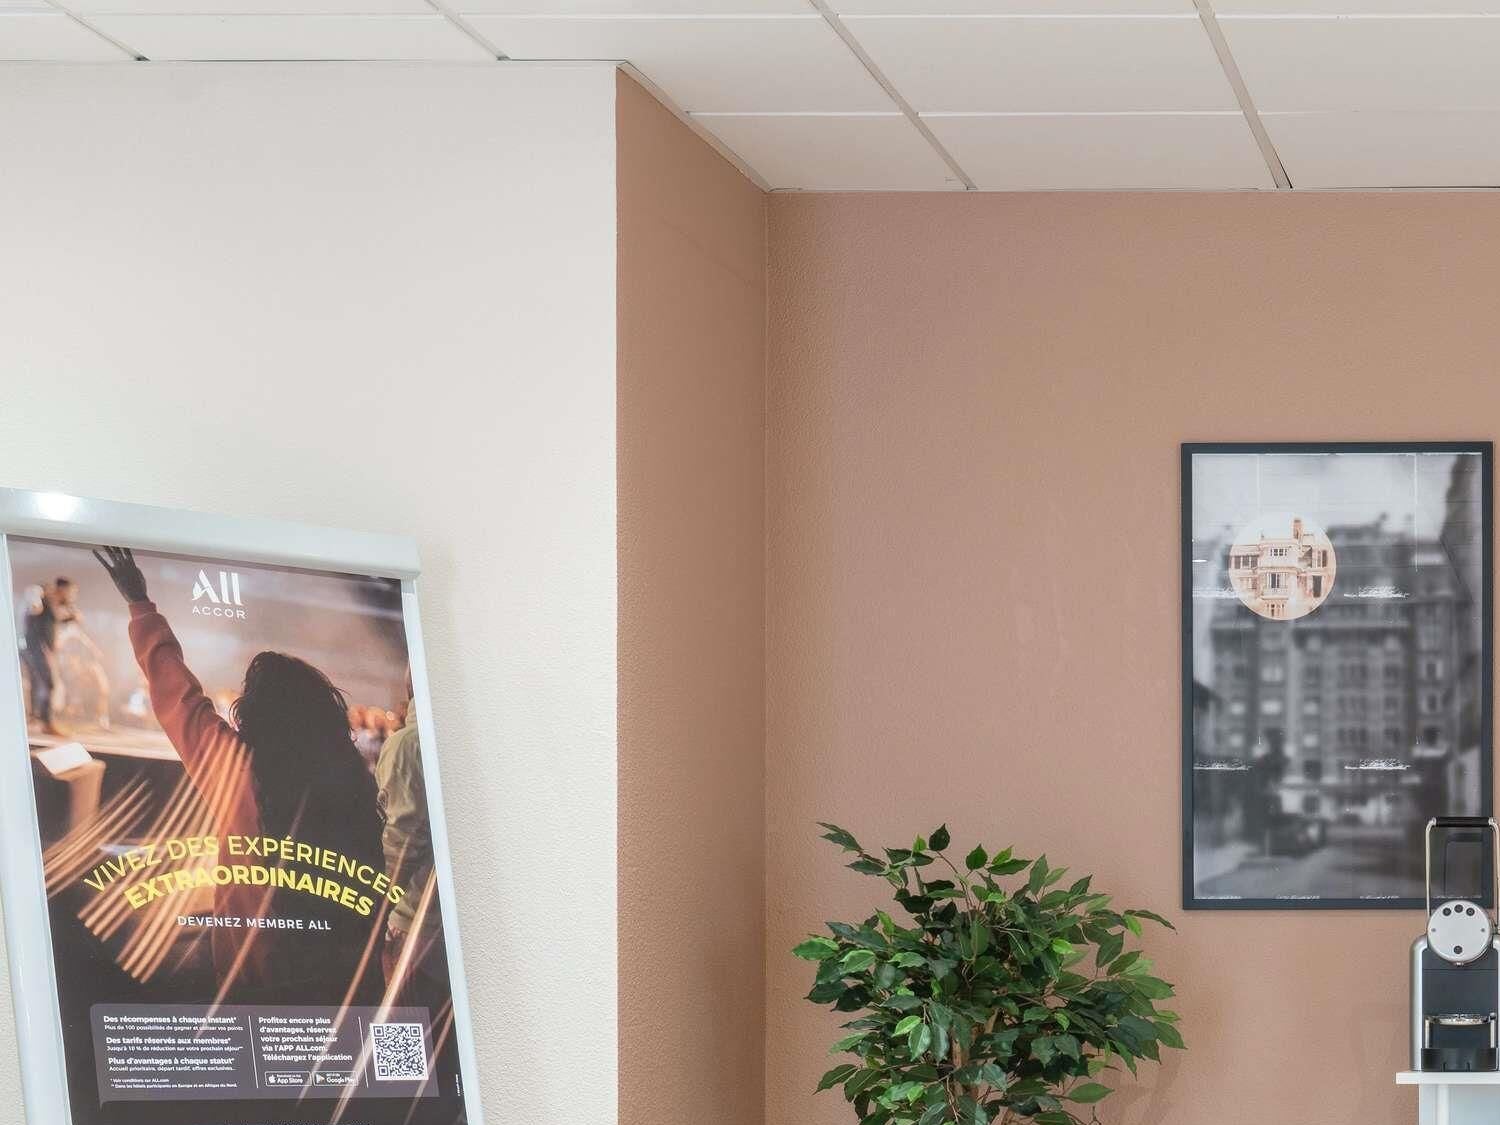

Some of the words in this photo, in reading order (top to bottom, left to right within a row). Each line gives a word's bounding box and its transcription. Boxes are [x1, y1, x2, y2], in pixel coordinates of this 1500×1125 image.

[192, 605, 246, 619] ACCOR
[83, 844, 162, 893] VIVEZ
[167, 836, 220, 860] DES
[228, 835, 405, 905] EXPÉRIENCES
[124, 865, 374, 916] EXTRAORDINAIRES
[177, 915, 242, 928] DEVENEZ
[246, 917, 304, 930] MEMBRE
[308, 919, 331, 931] ALL
[120, 1016, 171, 1024] récompenses
[178, 1016, 207, 1024] chaque
[315, 1017, 331, 1025] plus
[122, 1036, 143, 1044] tarifs
[282, 1035, 314, 1043] prochain
[315, 1035, 338, 1043] séjour
[127, 1057, 172, 1065] d'avantages
[180, 1057, 208, 1065] chaque
[263, 1054, 307, 1062] Téléchargez
[308, 1054, 352, 1062] l'application
